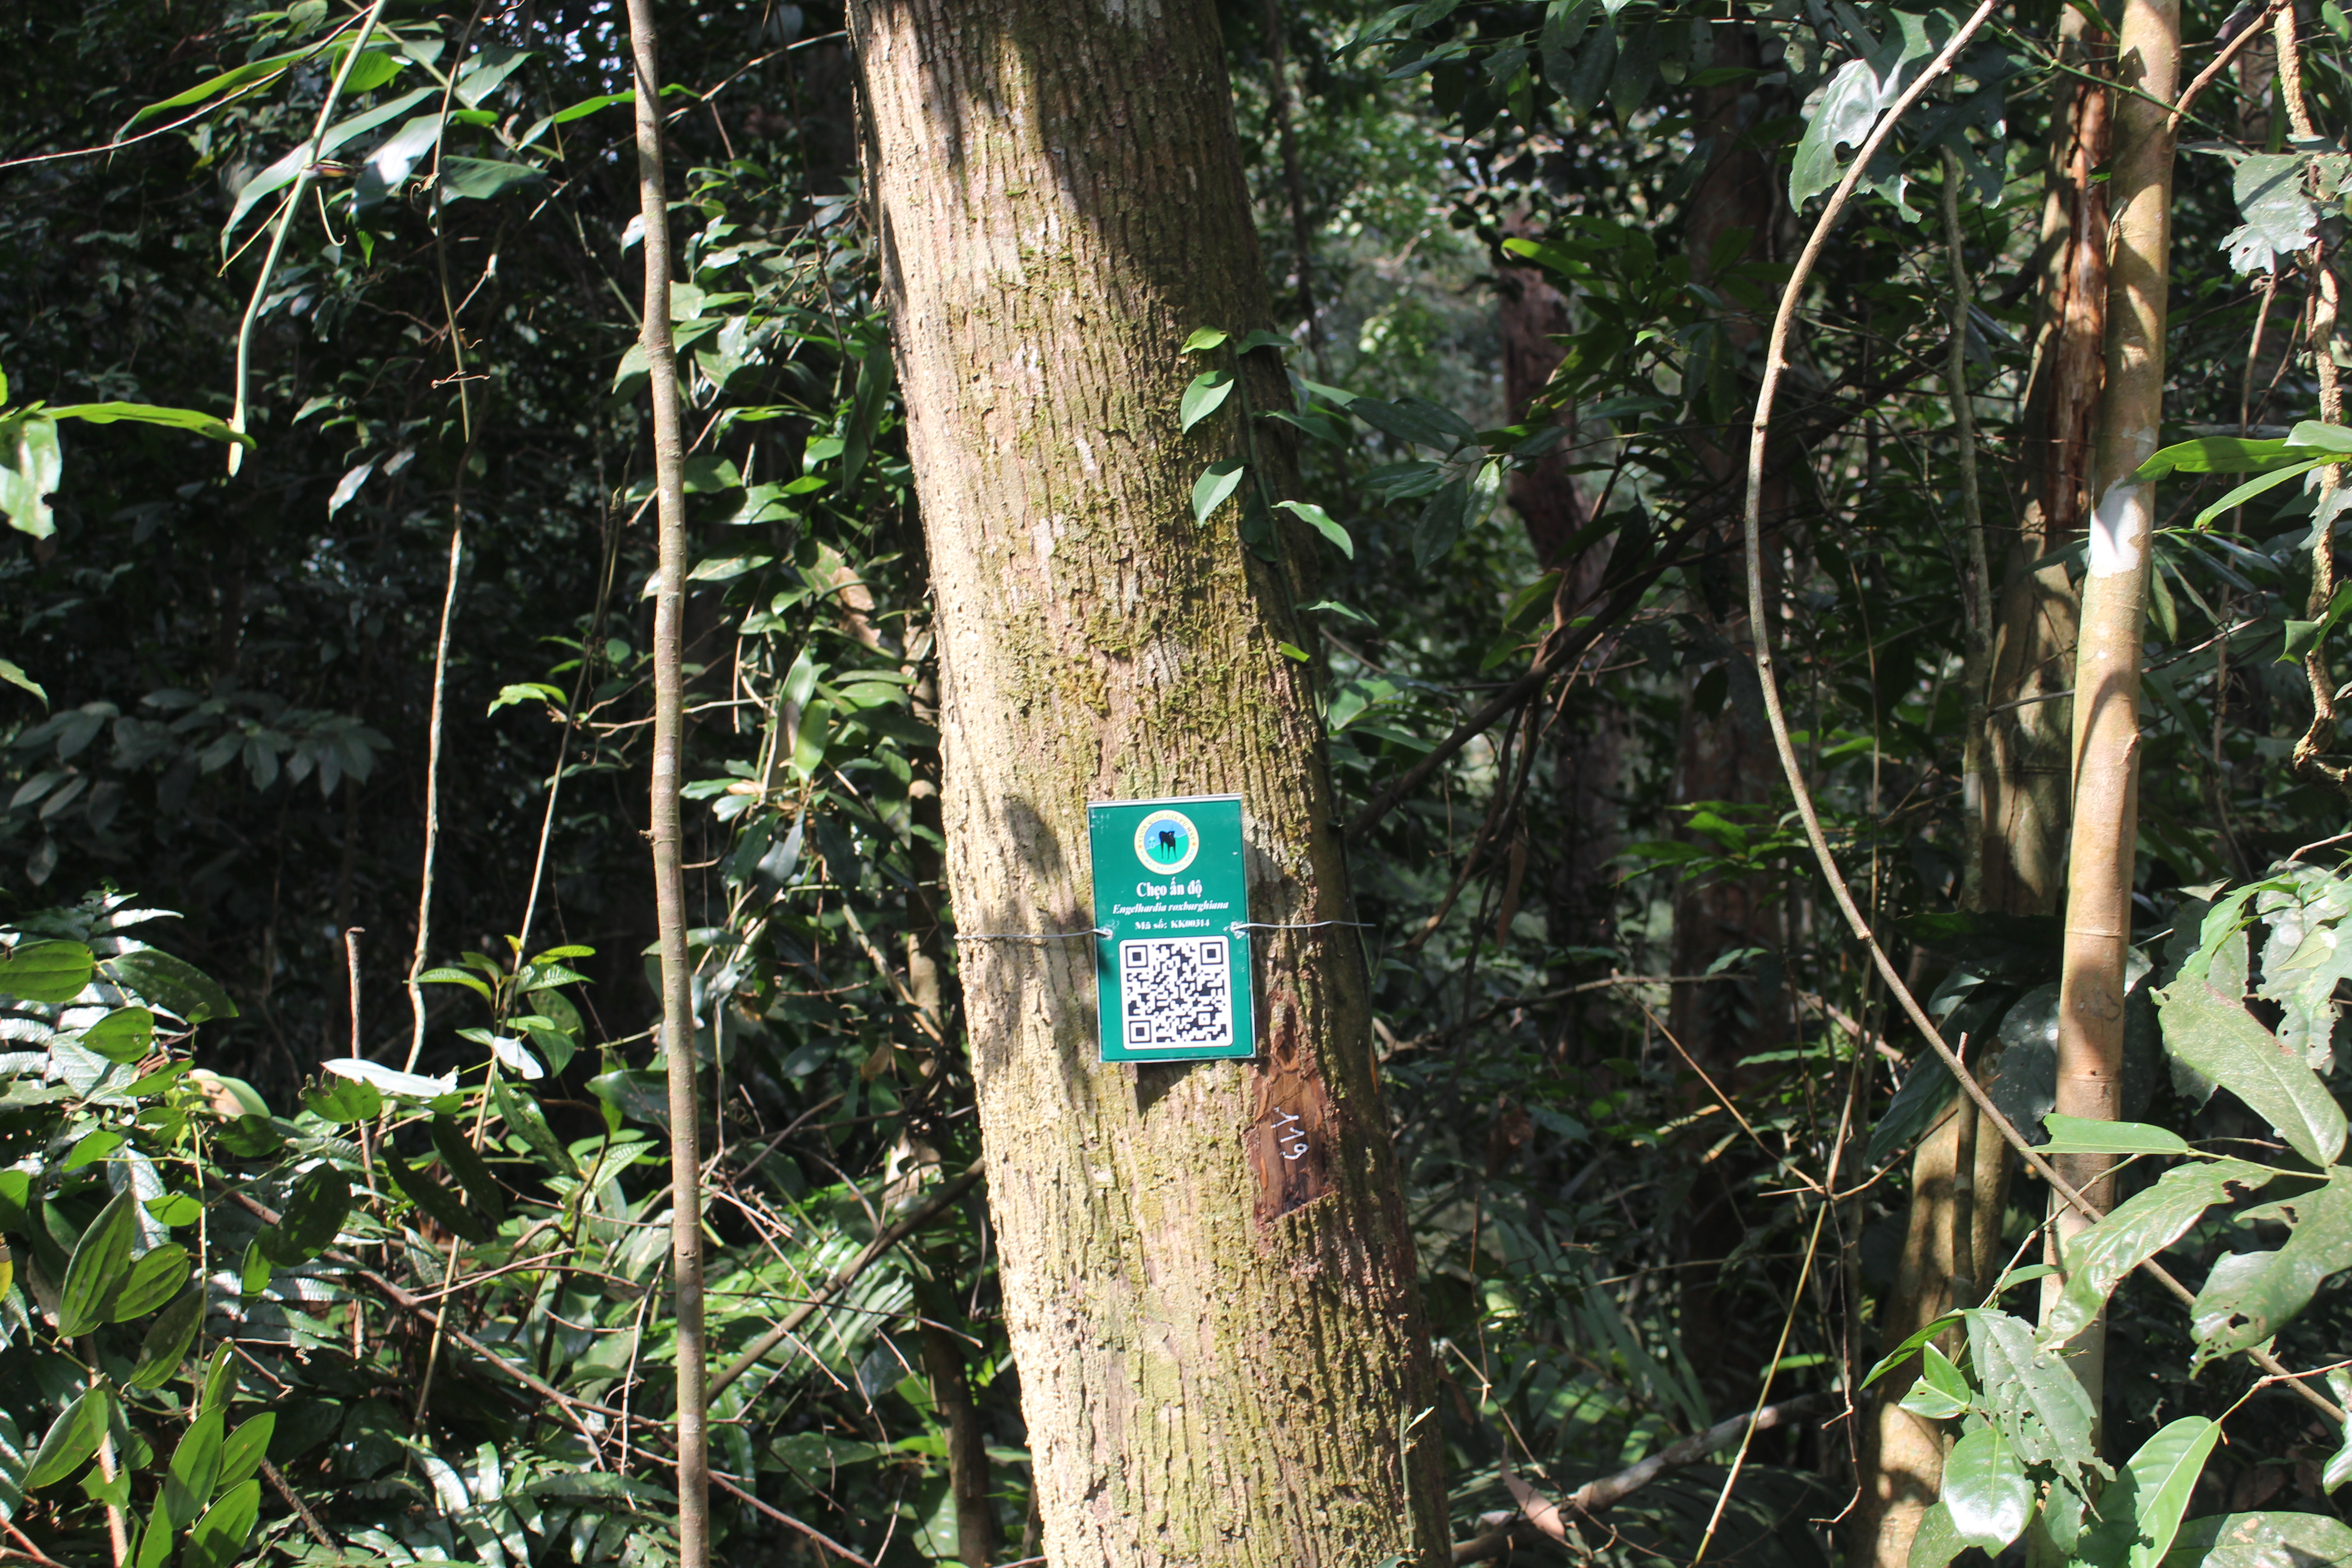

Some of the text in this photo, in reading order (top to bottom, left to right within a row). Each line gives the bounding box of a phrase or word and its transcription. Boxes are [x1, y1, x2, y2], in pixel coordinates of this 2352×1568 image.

[1136, 877, 1203, 900] Chẹo ấn độ
[1112, 900, 1230, 916] Engelhardia roxburghiana
[1135, 918, 1210, 930] Mã số: KK00314
